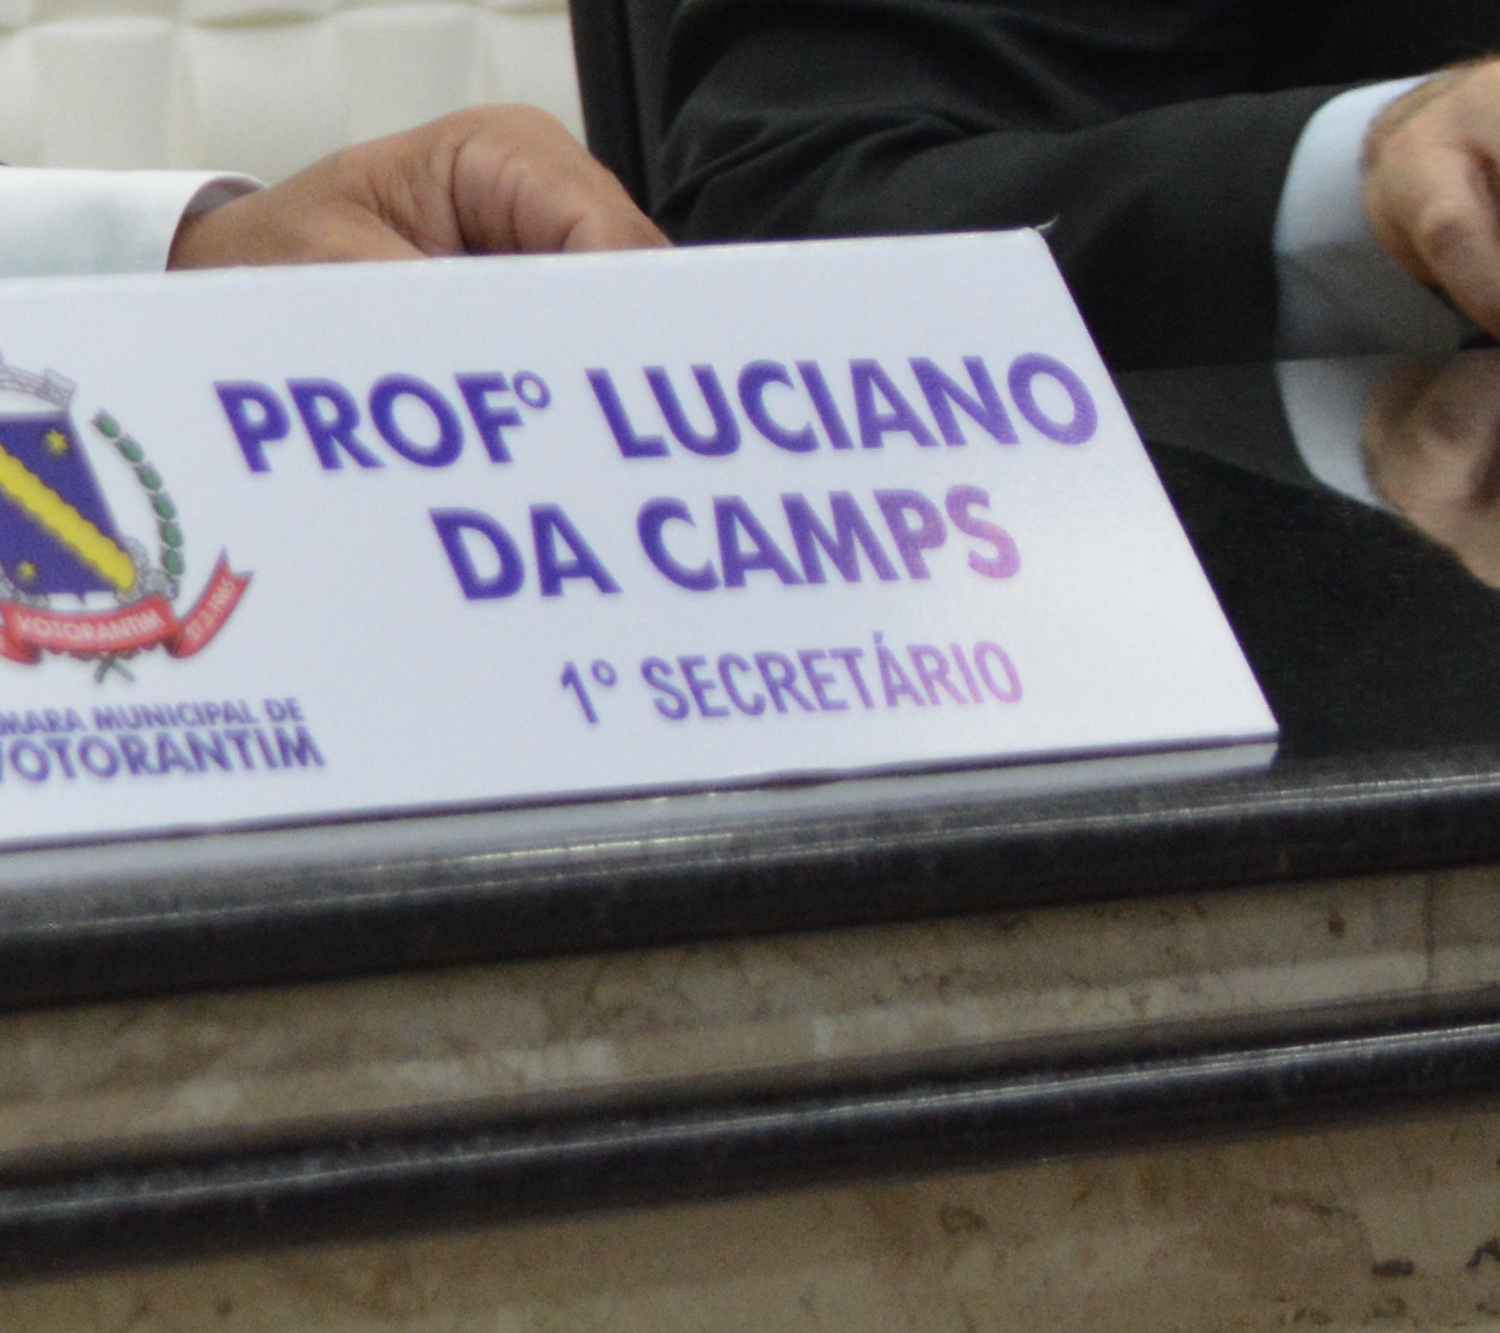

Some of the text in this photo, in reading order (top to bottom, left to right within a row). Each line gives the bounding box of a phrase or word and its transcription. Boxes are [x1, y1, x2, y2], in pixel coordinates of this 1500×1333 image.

[585, 352, 1098, 459] LUCIANO
[428, 484, 1021, 601] DA CAMPS
[11, 608, 166, 641] VOTORANTIM
[91, 699, 260, 730] MUNICIPAL
[263, 696, 306, 723] DE
[640, 631, 1024, 721] SECRETÁRIO
